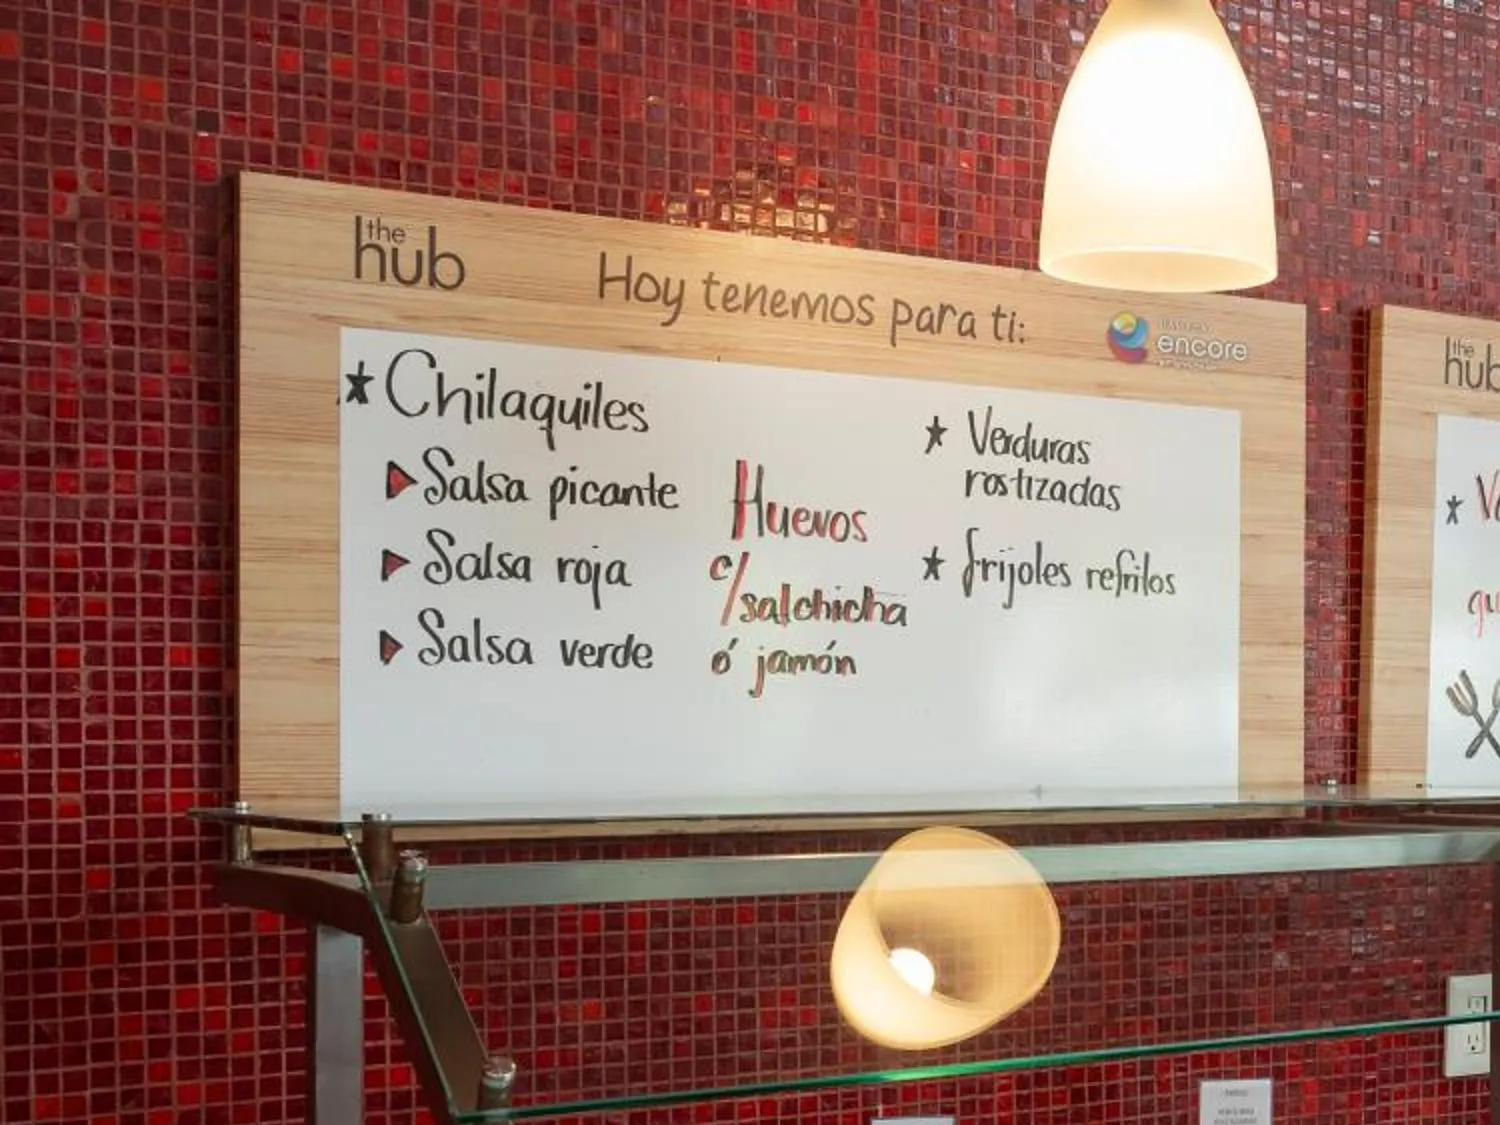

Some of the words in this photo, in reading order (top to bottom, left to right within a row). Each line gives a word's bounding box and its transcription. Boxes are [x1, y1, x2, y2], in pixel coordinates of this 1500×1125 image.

[355, 216, 466, 290] hub
[365, 219, 406, 243] the
[598, 252, 685, 327] Hoy
[702, 271, 876, 327] tenemos
[888, 297, 978, 347] para
[991, 303, 1028, 344] ti:
[1157, 335, 1248, 362] encore
[386, 349, 650, 451] Chilaquiles
[967, 405, 1092, 465] Verduras
[422, 447, 529, 504] Salsa
[548, 466, 680, 521] picante
[729, 460, 868, 541] Huevos
[964, 467, 1121, 512] rostizadas
[423, 529, 532, 585] Salsa
[557, 547, 632, 610] roja
[417, 608, 533, 666] Salsa
[560, 633, 653, 669] verde
[747, 640, 857, 698] jamón
